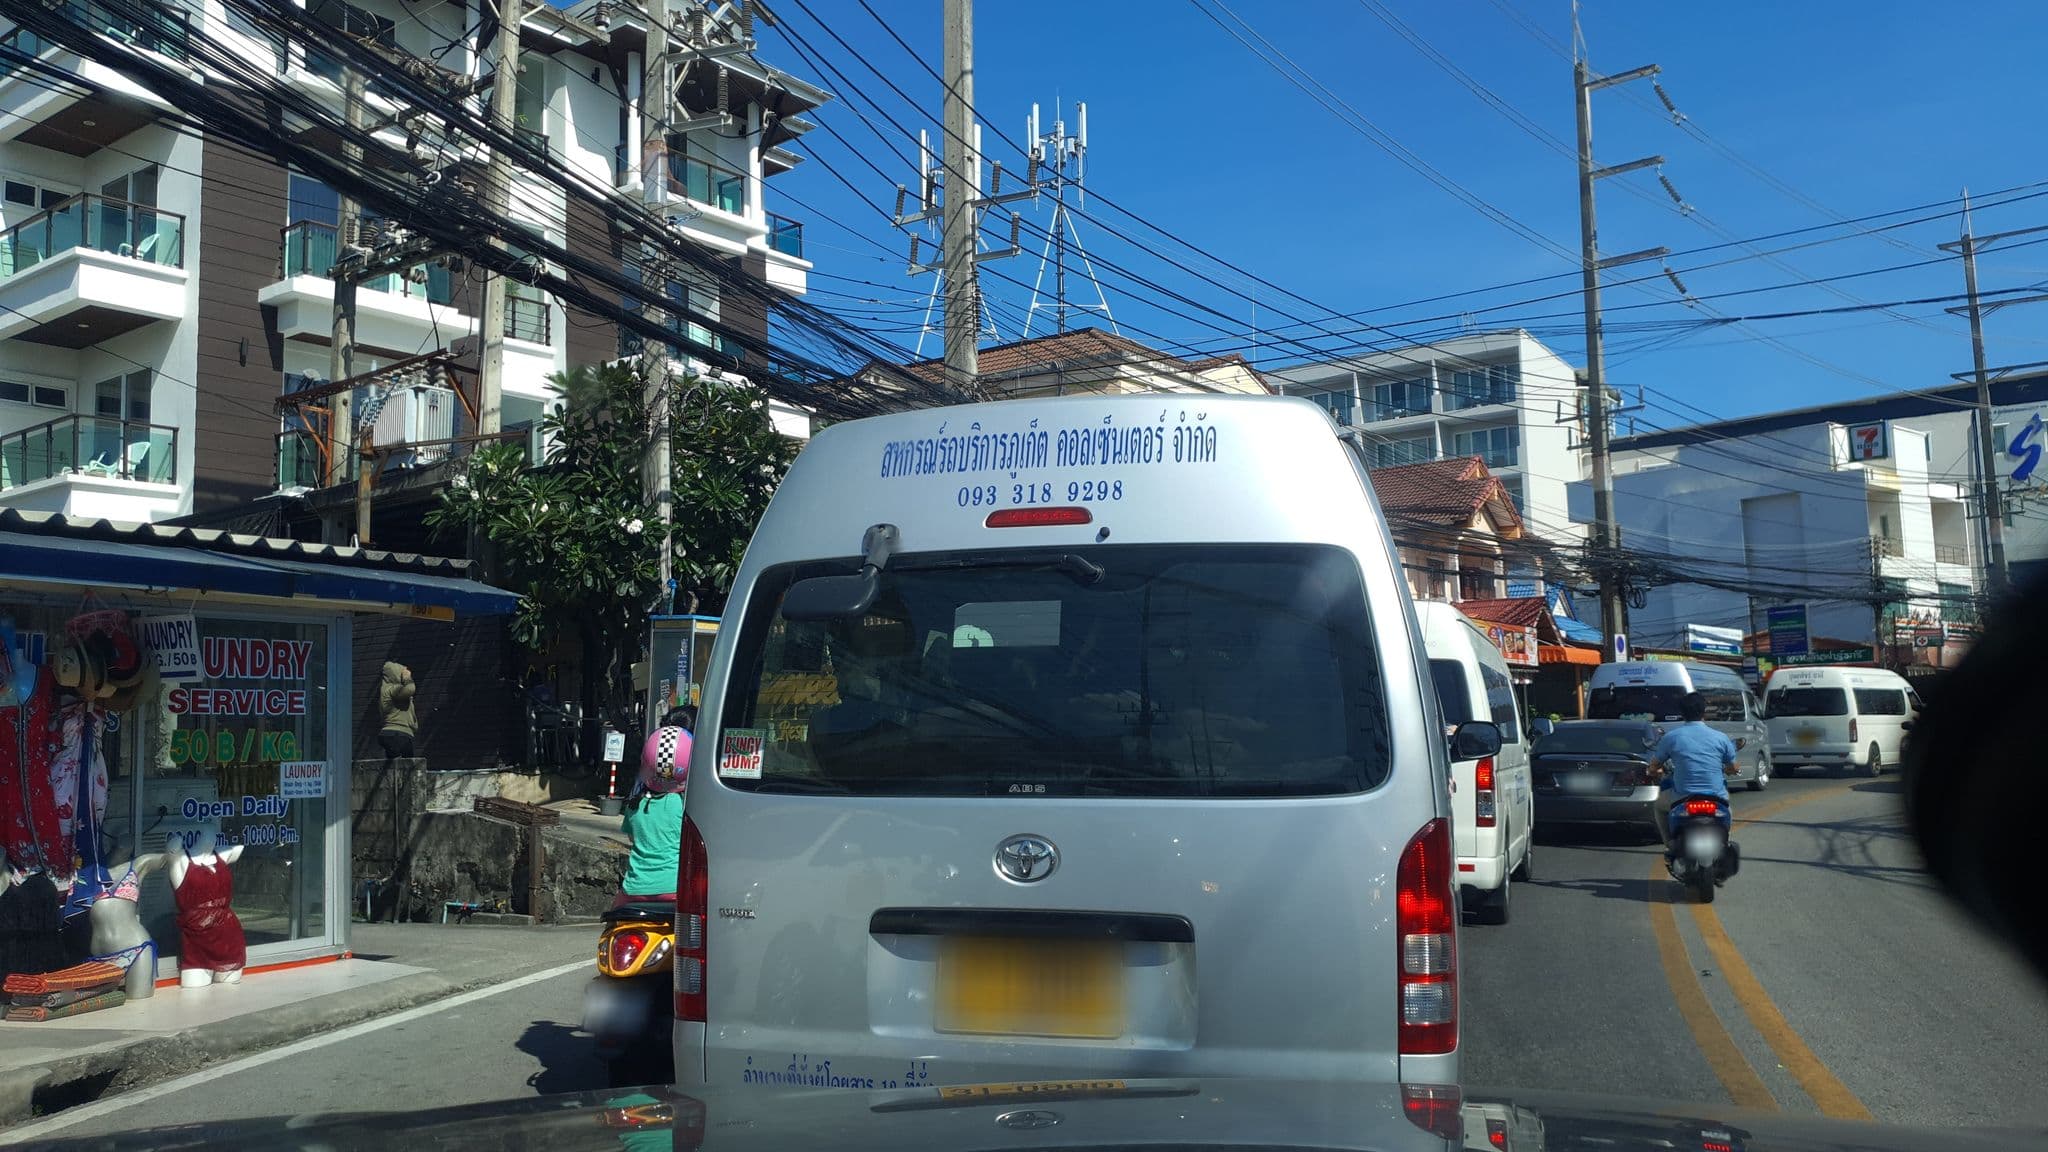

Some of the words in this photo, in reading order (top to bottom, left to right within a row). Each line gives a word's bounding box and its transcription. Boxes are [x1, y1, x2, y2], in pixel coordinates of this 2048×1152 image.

[1056, 408, 1167, 467] คอลเซ็นเตอร์
[1173, 410, 1217, 464] จำกัด
[958, 485, 997, 507] 093
[1012, 482, 1052, 504] 318
[1067, 479, 1123, 502] 9298
[203, 637, 313, 680] UNDRY
[168, 688, 306, 715] SERVICE
[170, 729, 209, 764] 50
[261, 731, 302, 762] KG.
[284, 764, 322, 779] LAUNDRY
[723, 755, 760, 770] JUMP
[183, 798, 235, 822] Open
[242, 795, 289, 818] Daily
[243, 824, 276, 846] 10:00
[279, 825, 300, 843] Pm.
